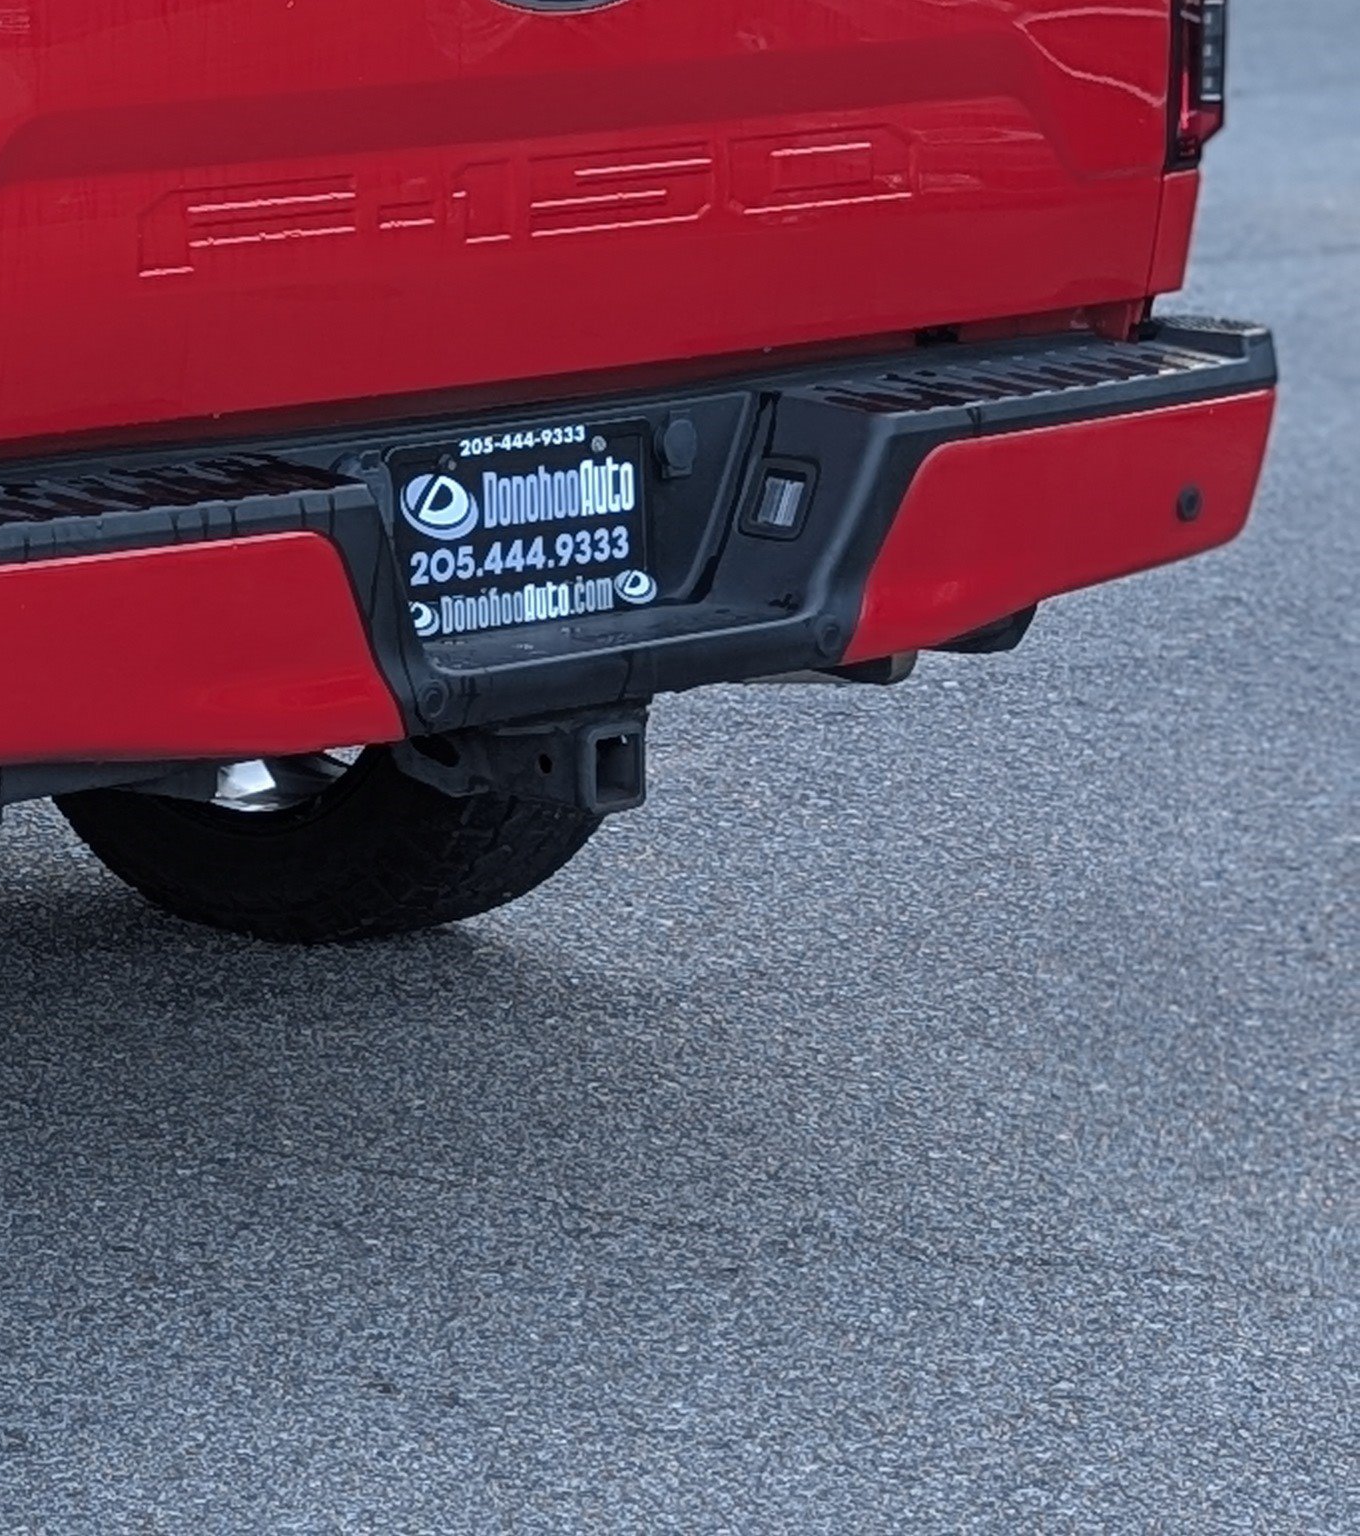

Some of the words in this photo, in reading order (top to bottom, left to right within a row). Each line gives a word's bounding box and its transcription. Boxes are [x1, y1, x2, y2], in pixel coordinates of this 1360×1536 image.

[137, 122, 915, 278] F-150
[459, 425, 586, 457] 205-444-9333
[410, 525, 630, 586] 205.444.9333
